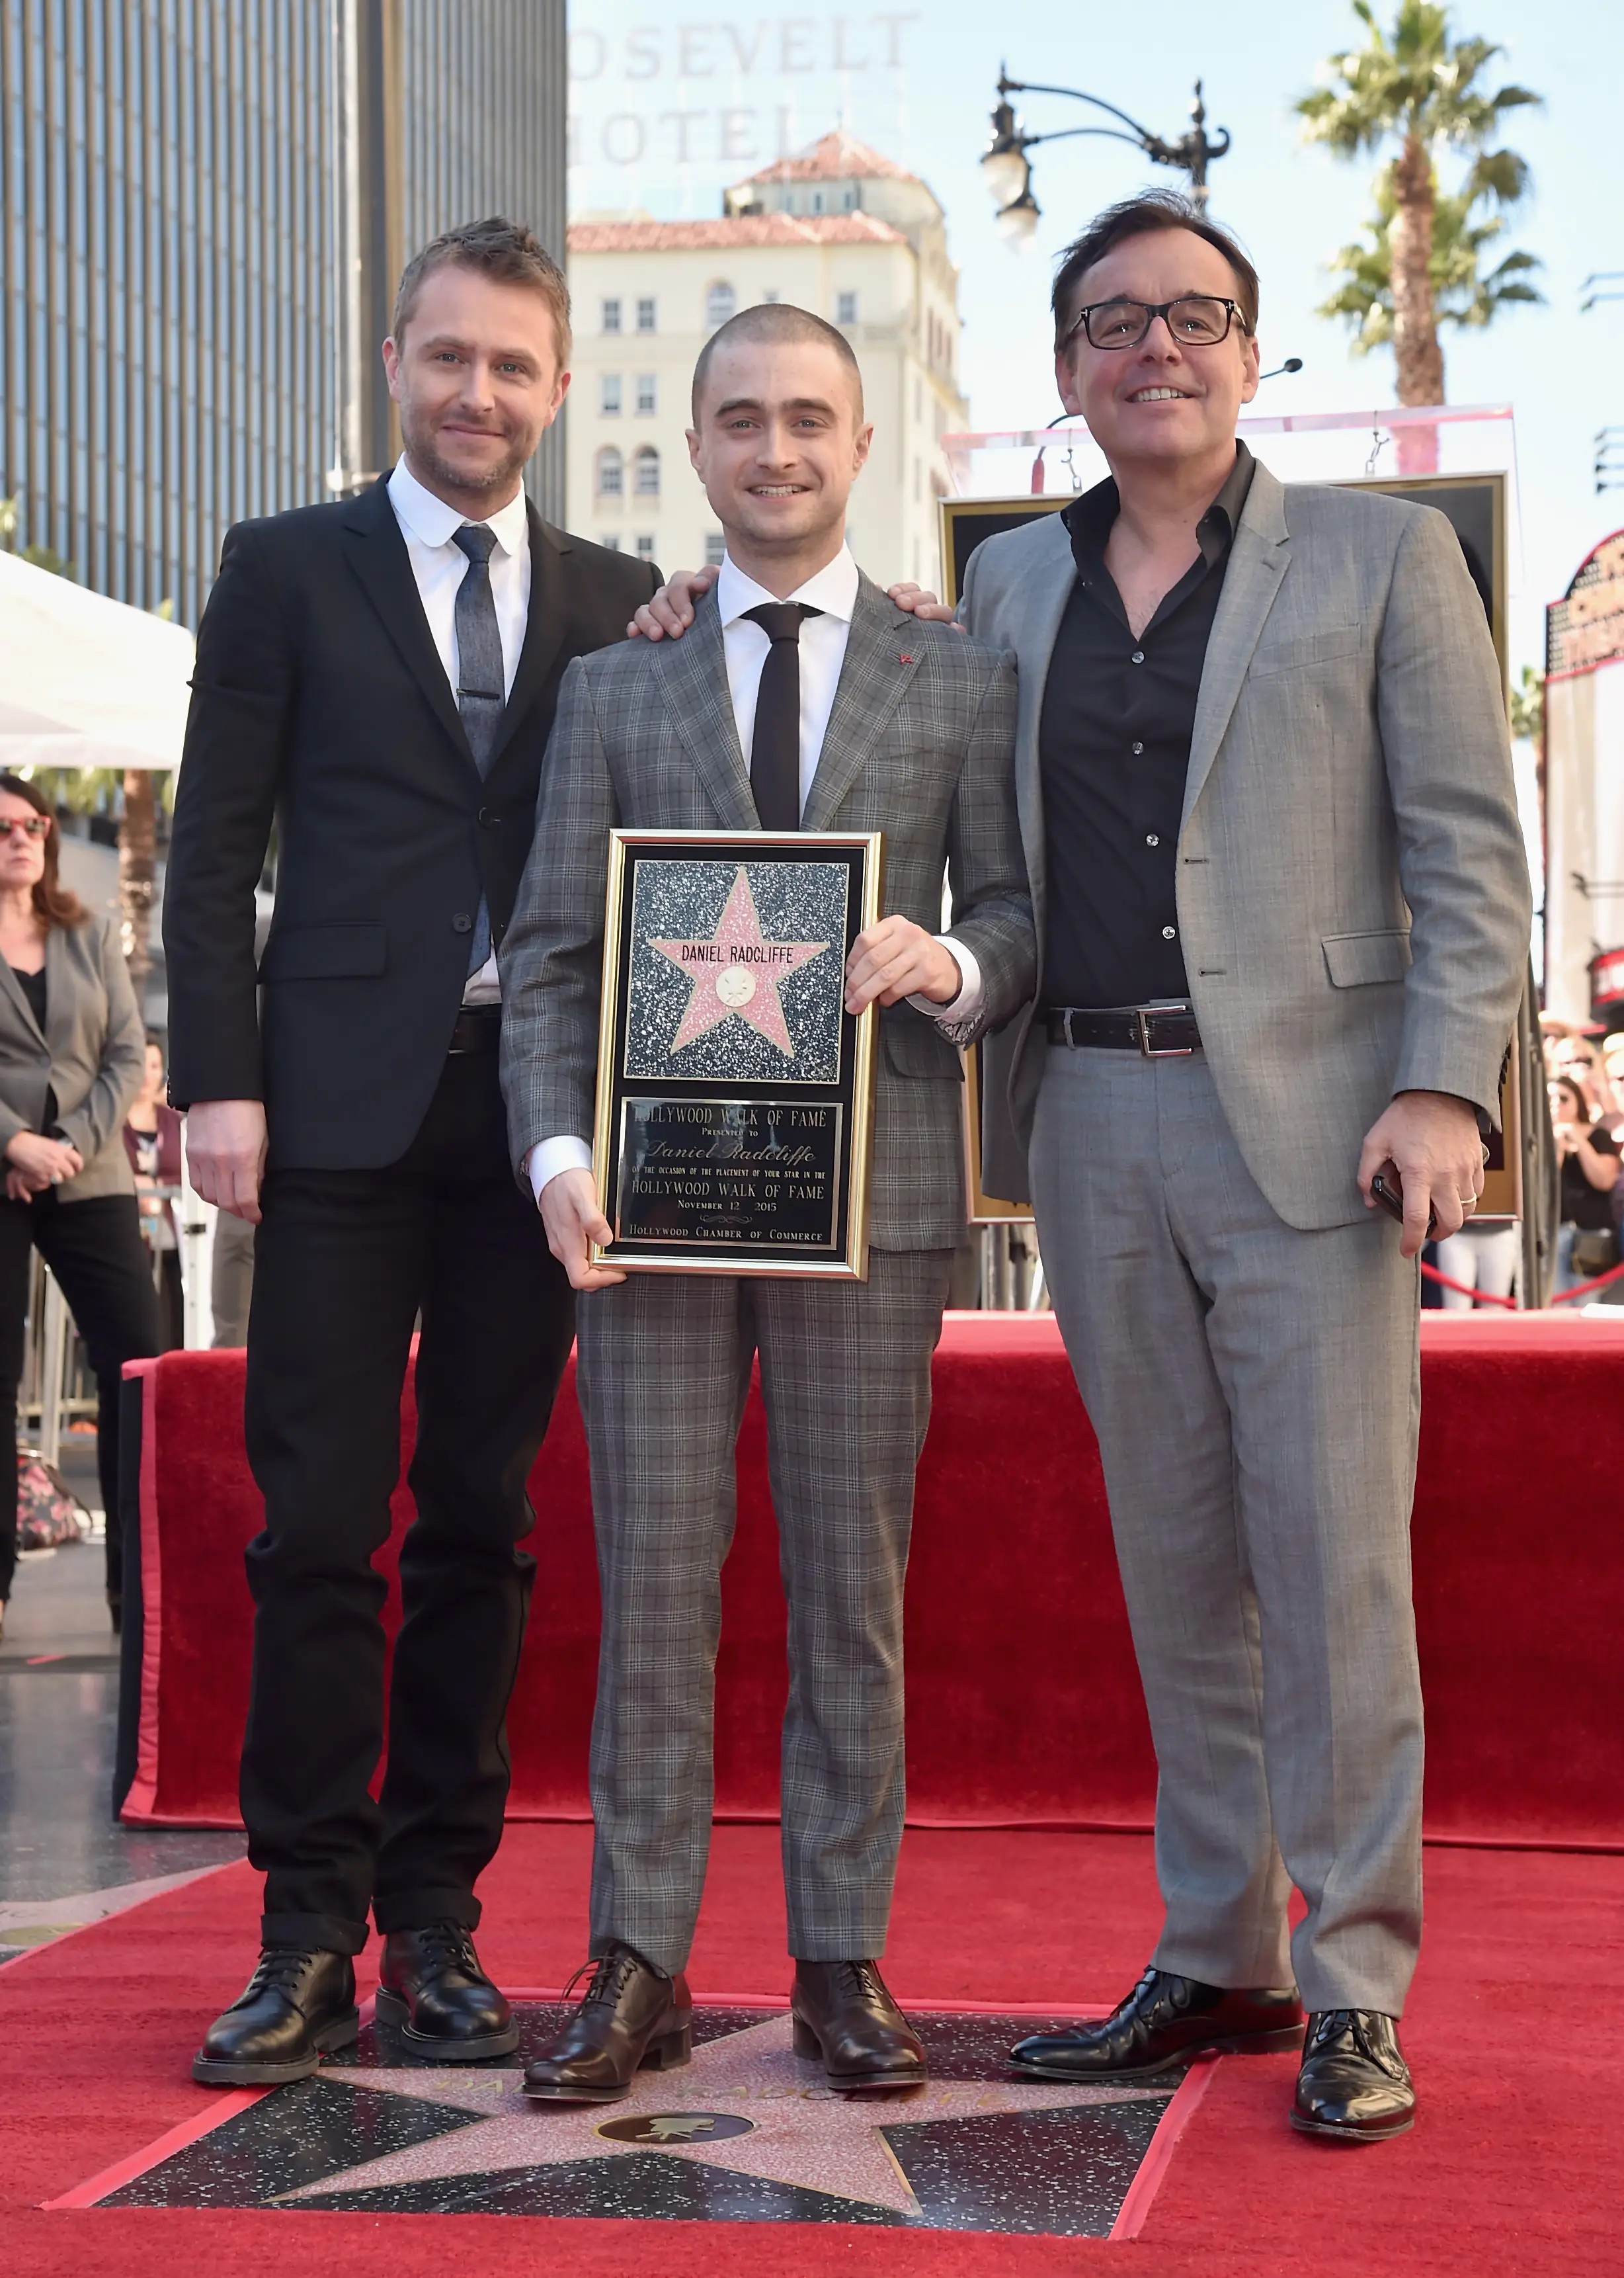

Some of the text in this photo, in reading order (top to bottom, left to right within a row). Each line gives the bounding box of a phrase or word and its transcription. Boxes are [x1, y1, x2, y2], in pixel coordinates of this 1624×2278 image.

[682, 945, 794, 964] DANIEL RADCLIFFE
[721, 1108, 758, 1125] WALK
[767, 1109, 784, 1126] OF
[791, 1111, 827, 1127] FAME
[647, 1139, 817, 1166] Daniel Radcliffe
[716, 1168, 749, 1177] PLACEMENT
[632, 1180, 824, 1200] HOLLYWOOD WALK OF FAME
[730, 1201, 741, 1210] 12
[754, 1202, 777, 1212] 2015
